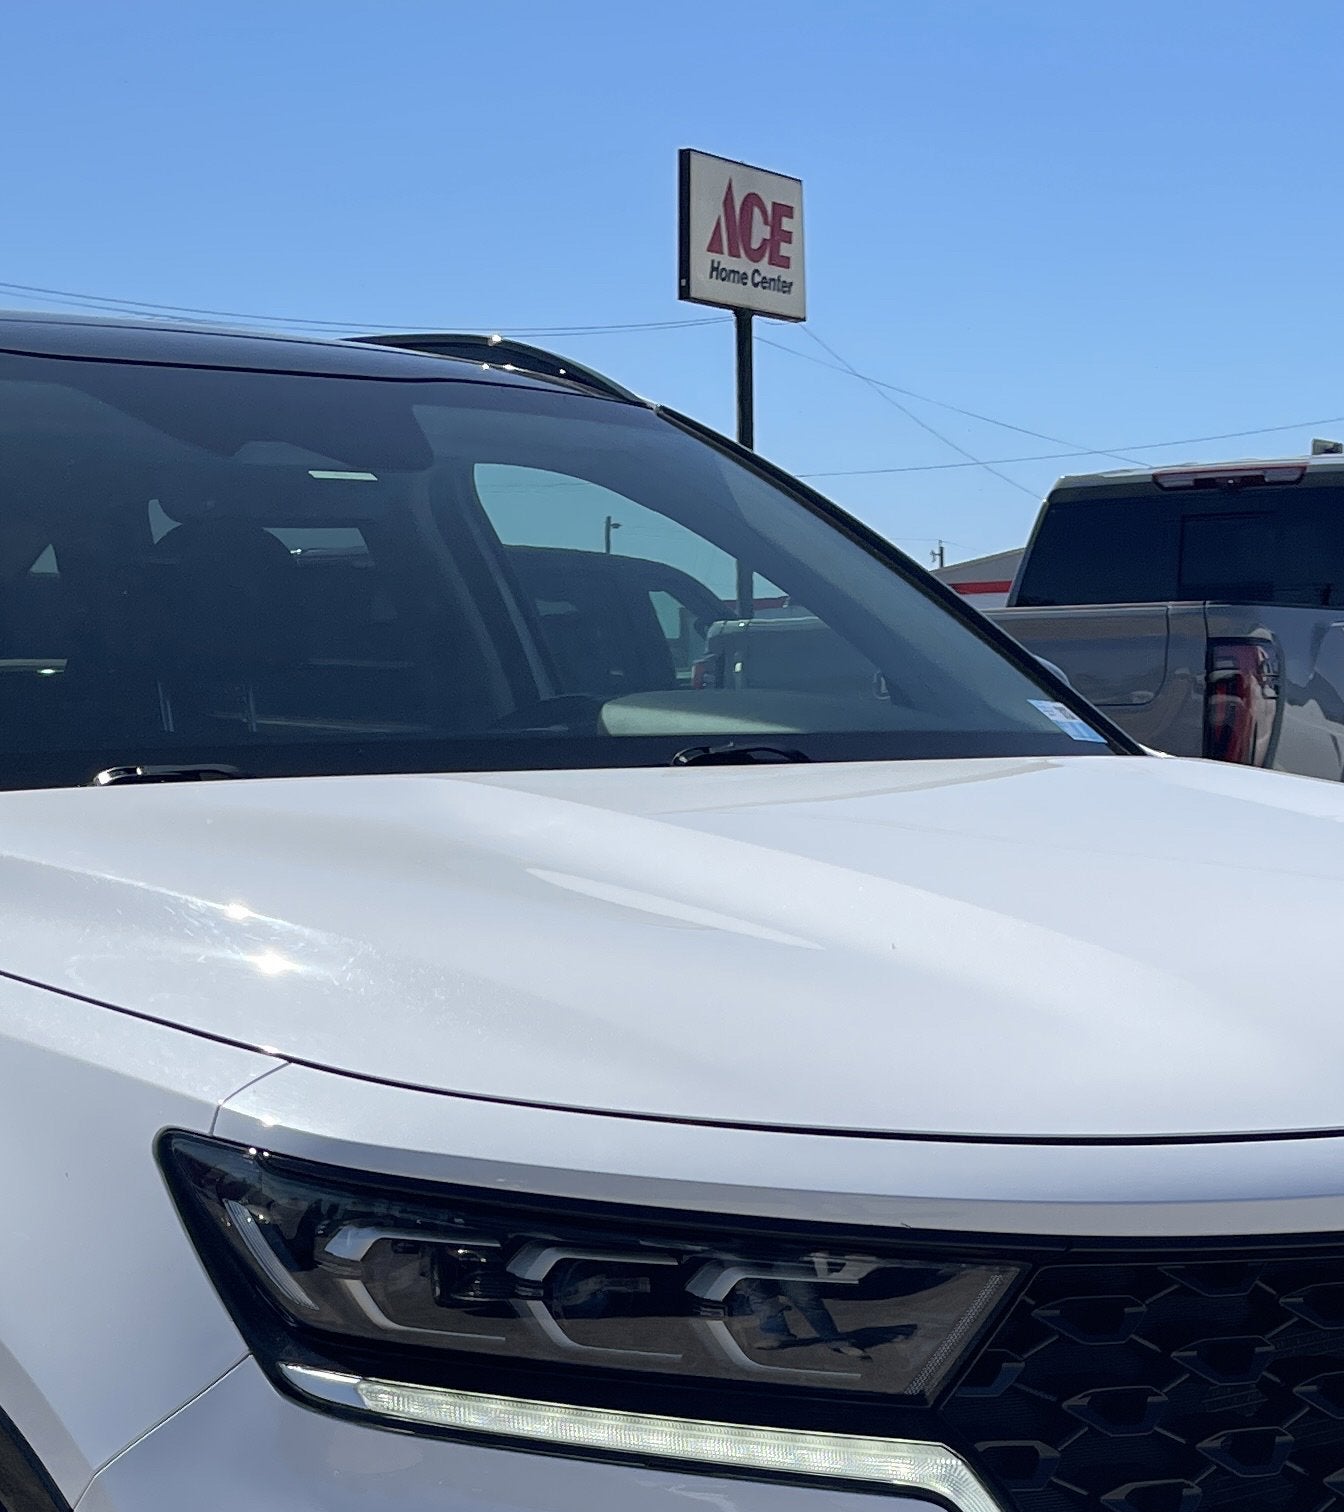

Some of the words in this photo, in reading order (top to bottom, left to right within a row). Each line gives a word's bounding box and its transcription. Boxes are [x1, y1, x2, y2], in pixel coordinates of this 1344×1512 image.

[706, 176, 794, 269] ACE
[709, 259, 748, 286] Home
[751, 269, 794, 294] Center
